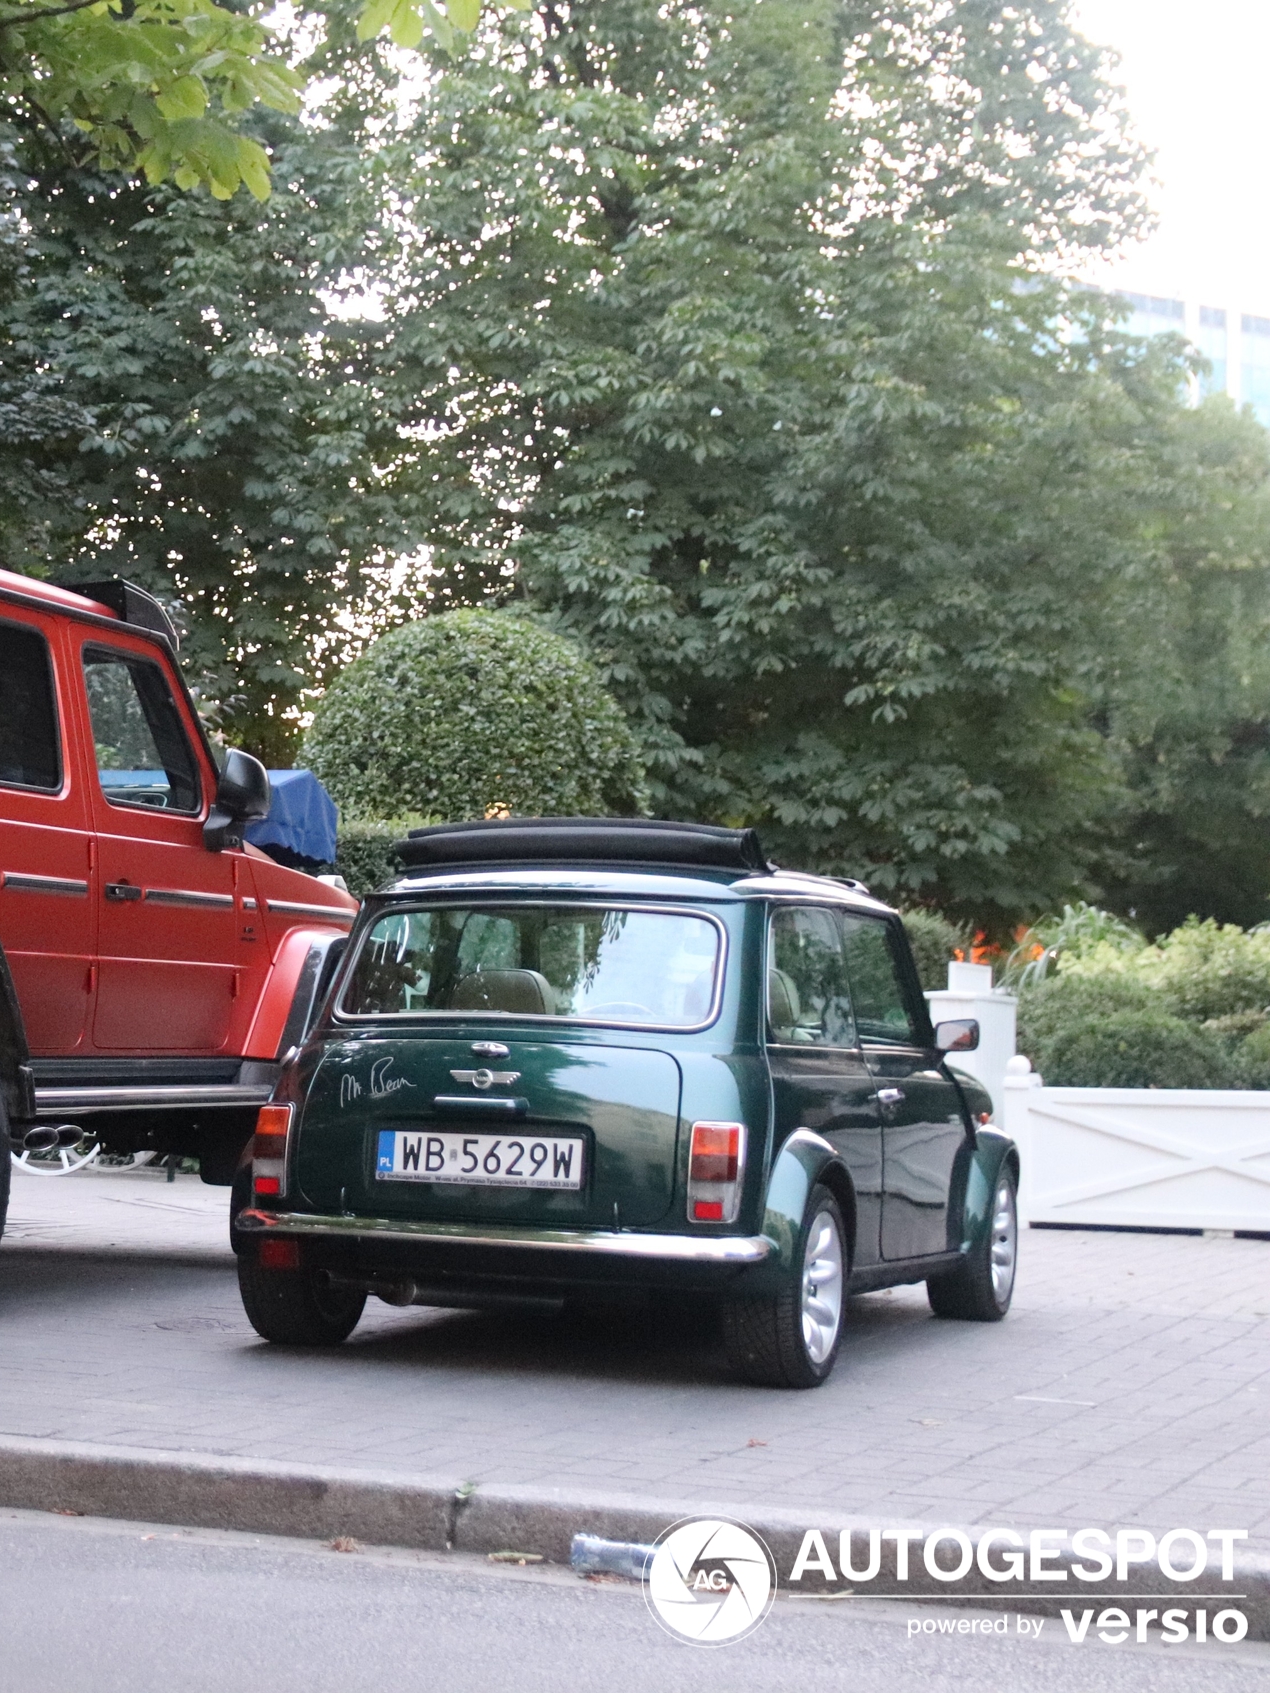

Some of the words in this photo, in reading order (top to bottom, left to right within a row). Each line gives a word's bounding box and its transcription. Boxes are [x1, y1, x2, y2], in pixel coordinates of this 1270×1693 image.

[370, 1056, 417, 1095] Bean
[380, 1156, 392, 1167] PL
[402, 1136, 445, 1172] WB
[460, 1138, 574, 1179] 5629W
